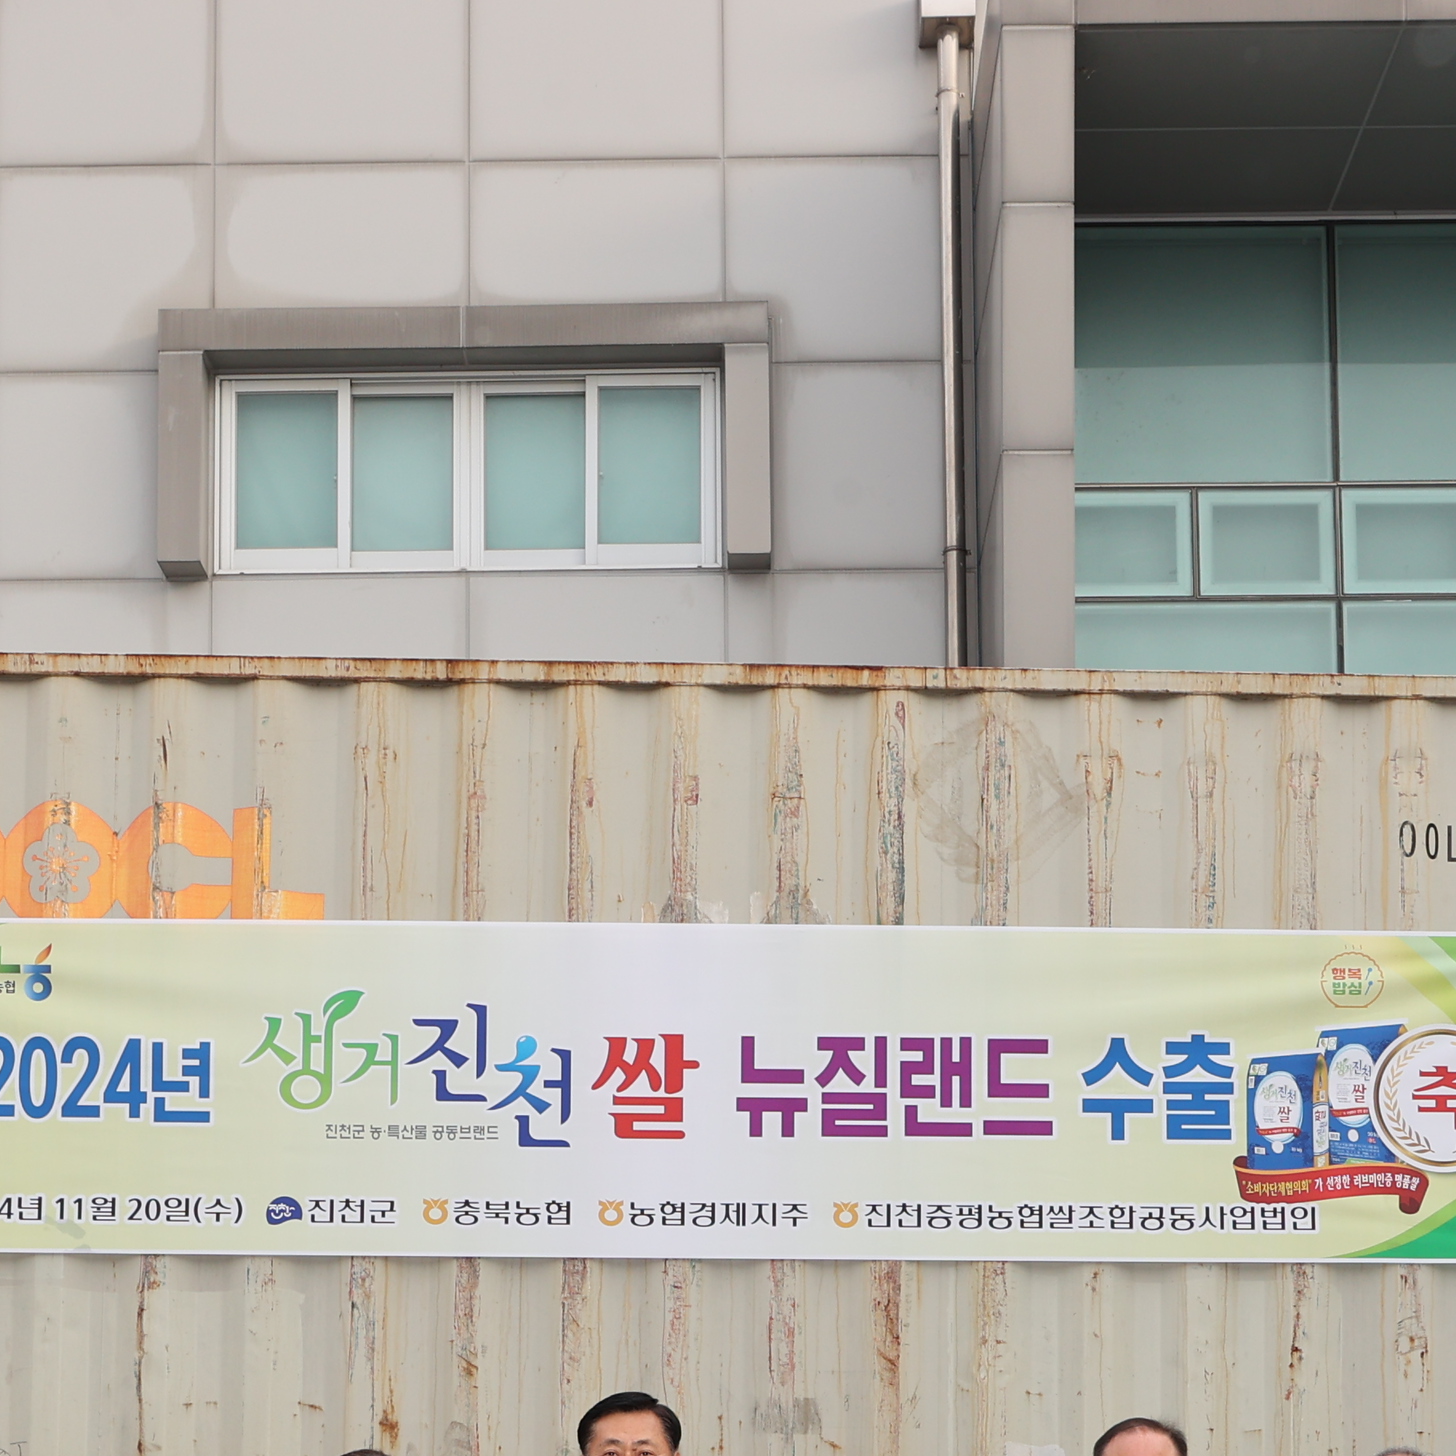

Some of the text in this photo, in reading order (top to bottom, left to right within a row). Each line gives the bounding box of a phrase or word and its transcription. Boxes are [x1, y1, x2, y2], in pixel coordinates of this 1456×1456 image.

[1331, 967, 1363, 981] 행복
[1331, 981, 1362, 995] 밥심
[241, 989, 572, 1148] 생거진천
[590, 1033, 700, 1140] 쌀
[735, 1035, 1055, 1138] 뉴질랜드
[1080, 1033, 1236, 1141] 수출
[1351, 1083, 1367, 1104] 쌀
[1277, 1106, 1292, 1124] 쌀
[324, 1123, 366, 1141] 진천군
[432, 1124, 500, 1142] 공동브랜드
[1314, 1178, 1324, 1192] 가
[1325, 1174, 1351, 1191] 선정한
[1353, 1172, 1393, 1189] 러브미인증
[1394, 1173, 1421, 1191] 명품쌀
[55, 1196, 118, 1223] 11월
[127, 1195, 244, 1227] 20일(수)
[307, 1197, 397, 1226] 진천군
[452, 1199, 572, 1227] 충북농협
[628, 1199, 810, 1229] 농협경제지주
[863, 1201, 1318, 1232] 진천증평농협쌀조합공동사업법인
